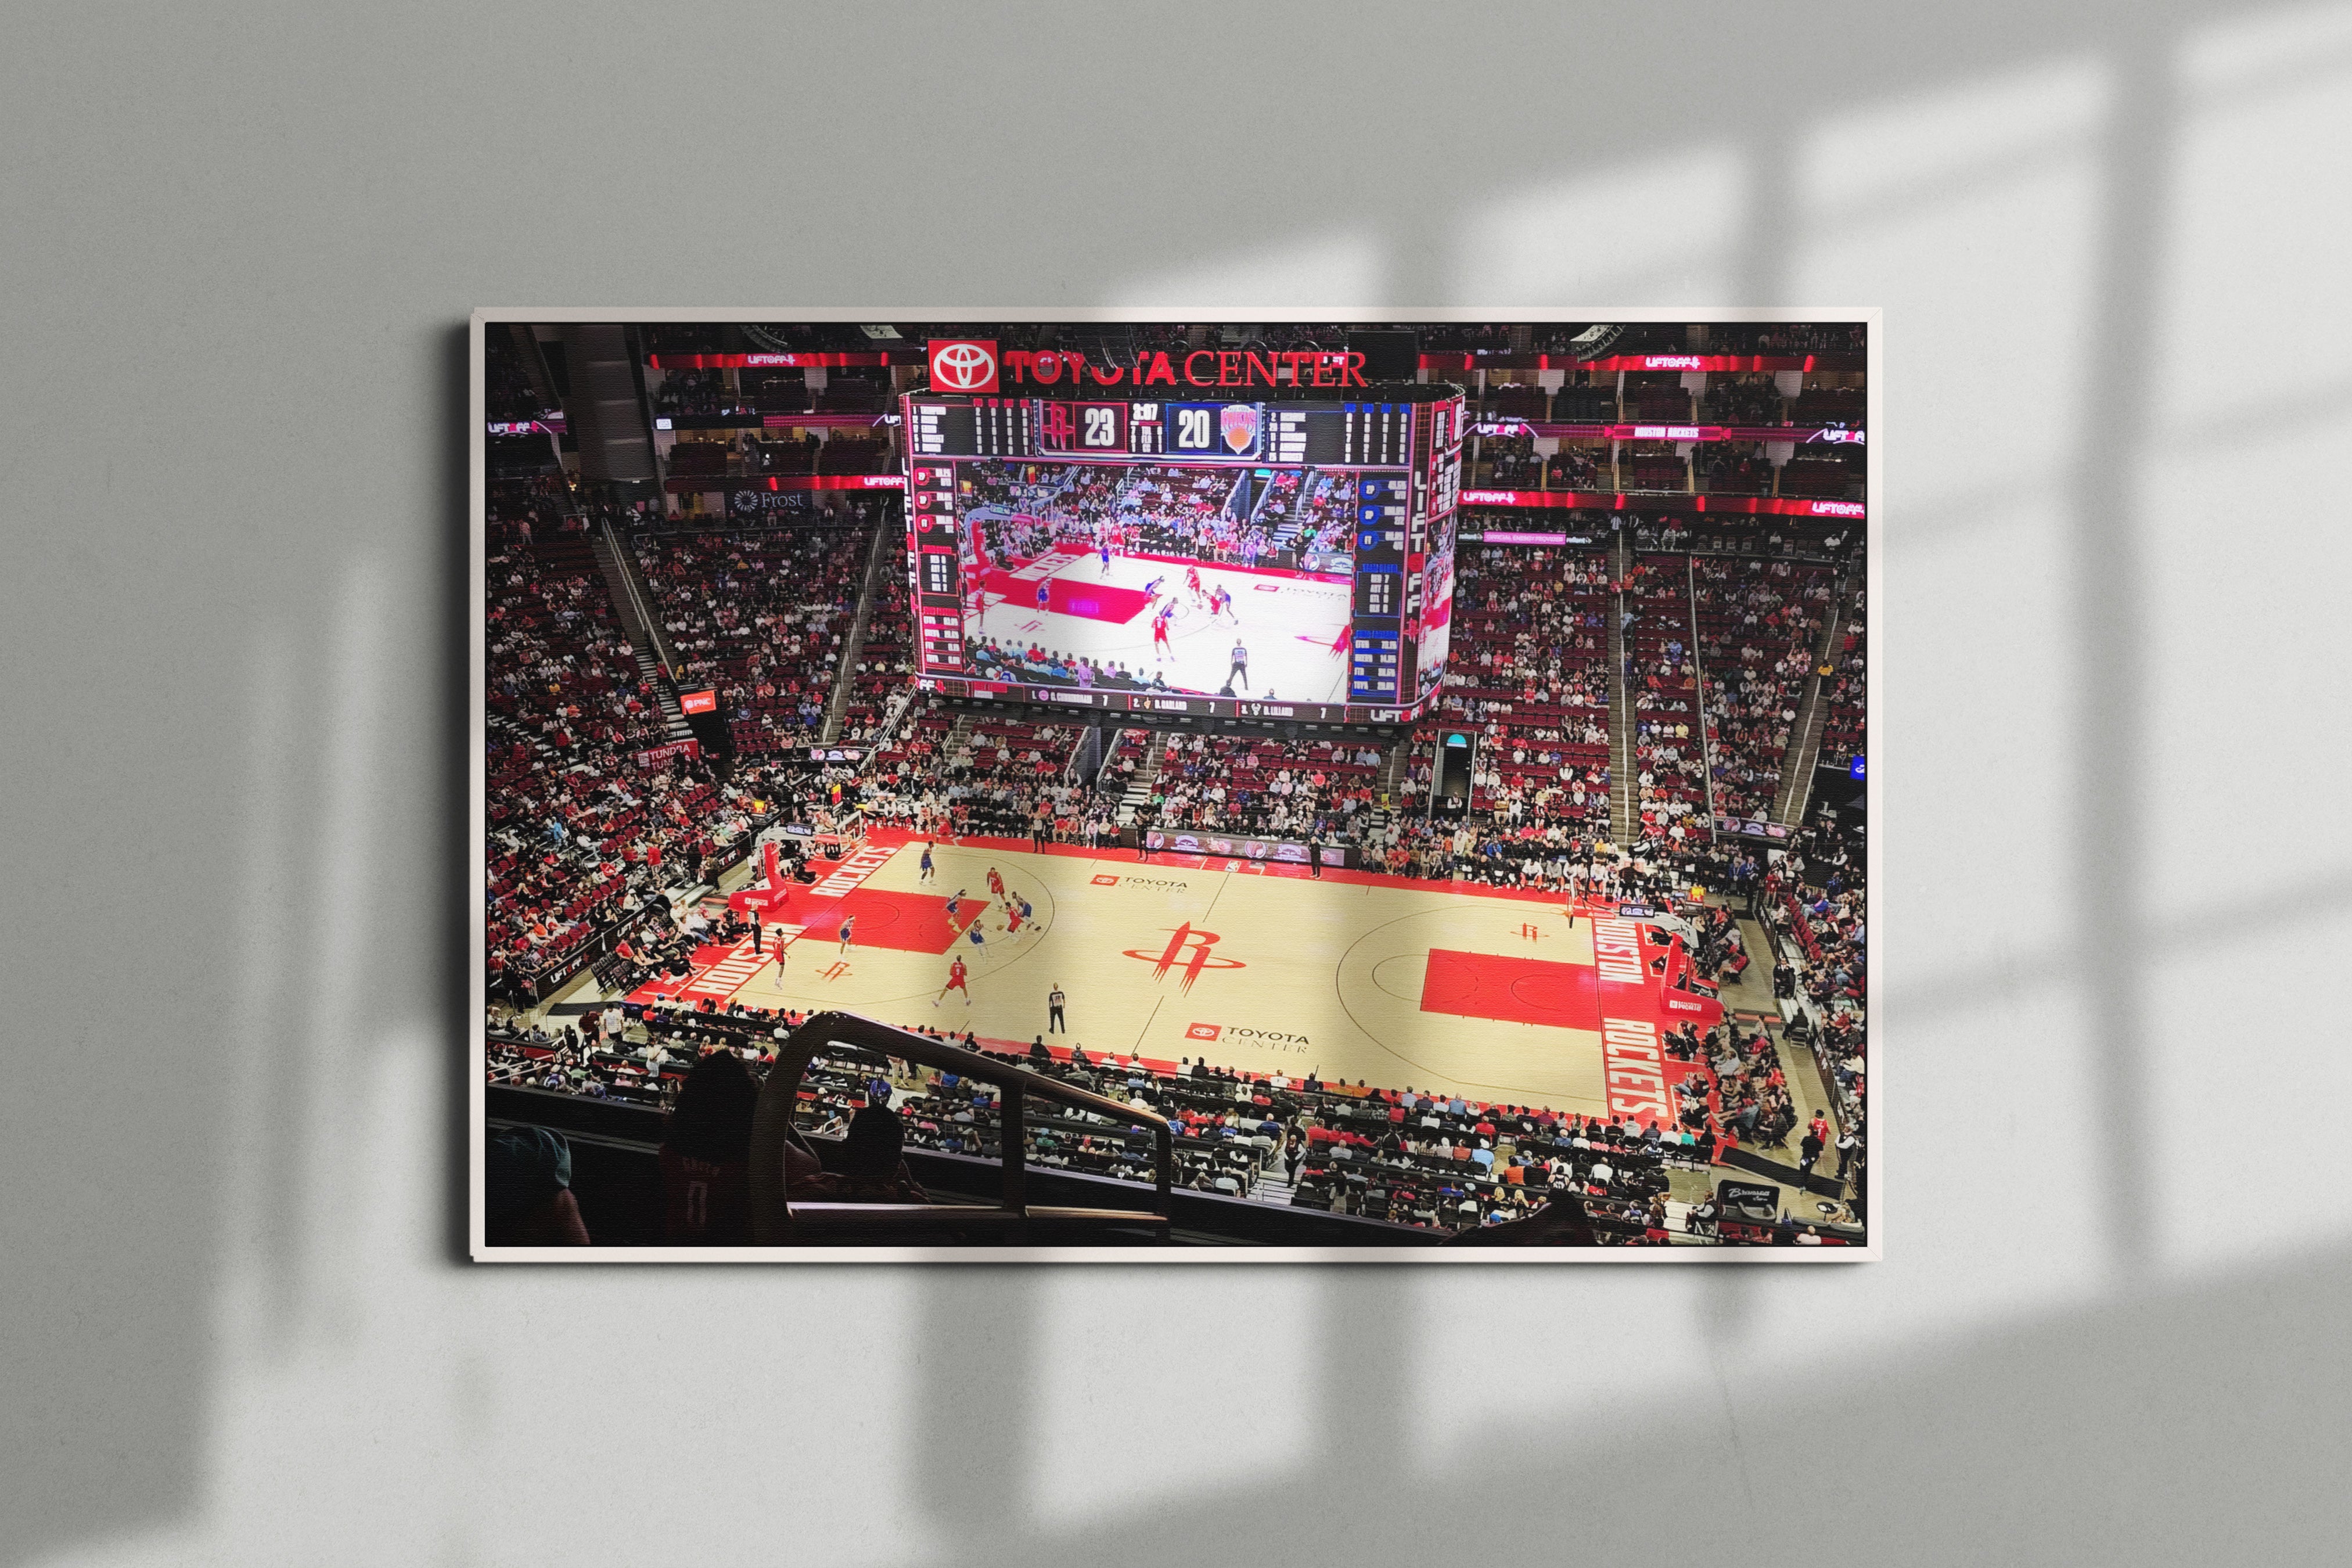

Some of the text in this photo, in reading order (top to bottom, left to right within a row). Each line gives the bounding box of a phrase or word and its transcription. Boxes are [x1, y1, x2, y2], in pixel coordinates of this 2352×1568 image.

[1184, 350, 1368, 387] CENTER
[1085, 408, 1114, 446] 23
[1179, 410, 1210, 448] 20
[761, 492, 803, 508] Frost
[1103, 695, 1108, 706] 7
[1209, 702, 1215, 713] 7
[1321, 707, 1326, 719] 7
[809, 846, 898, 897] ROCKETS
[1124, 877, 1188, 888] TOYOTA
[1595, 919, 1644, 984] HOUSTON
[1228, 1027, 1309, 1045] TOYOTA
[1604, 1017, 1668, 1117] ROCKETS
